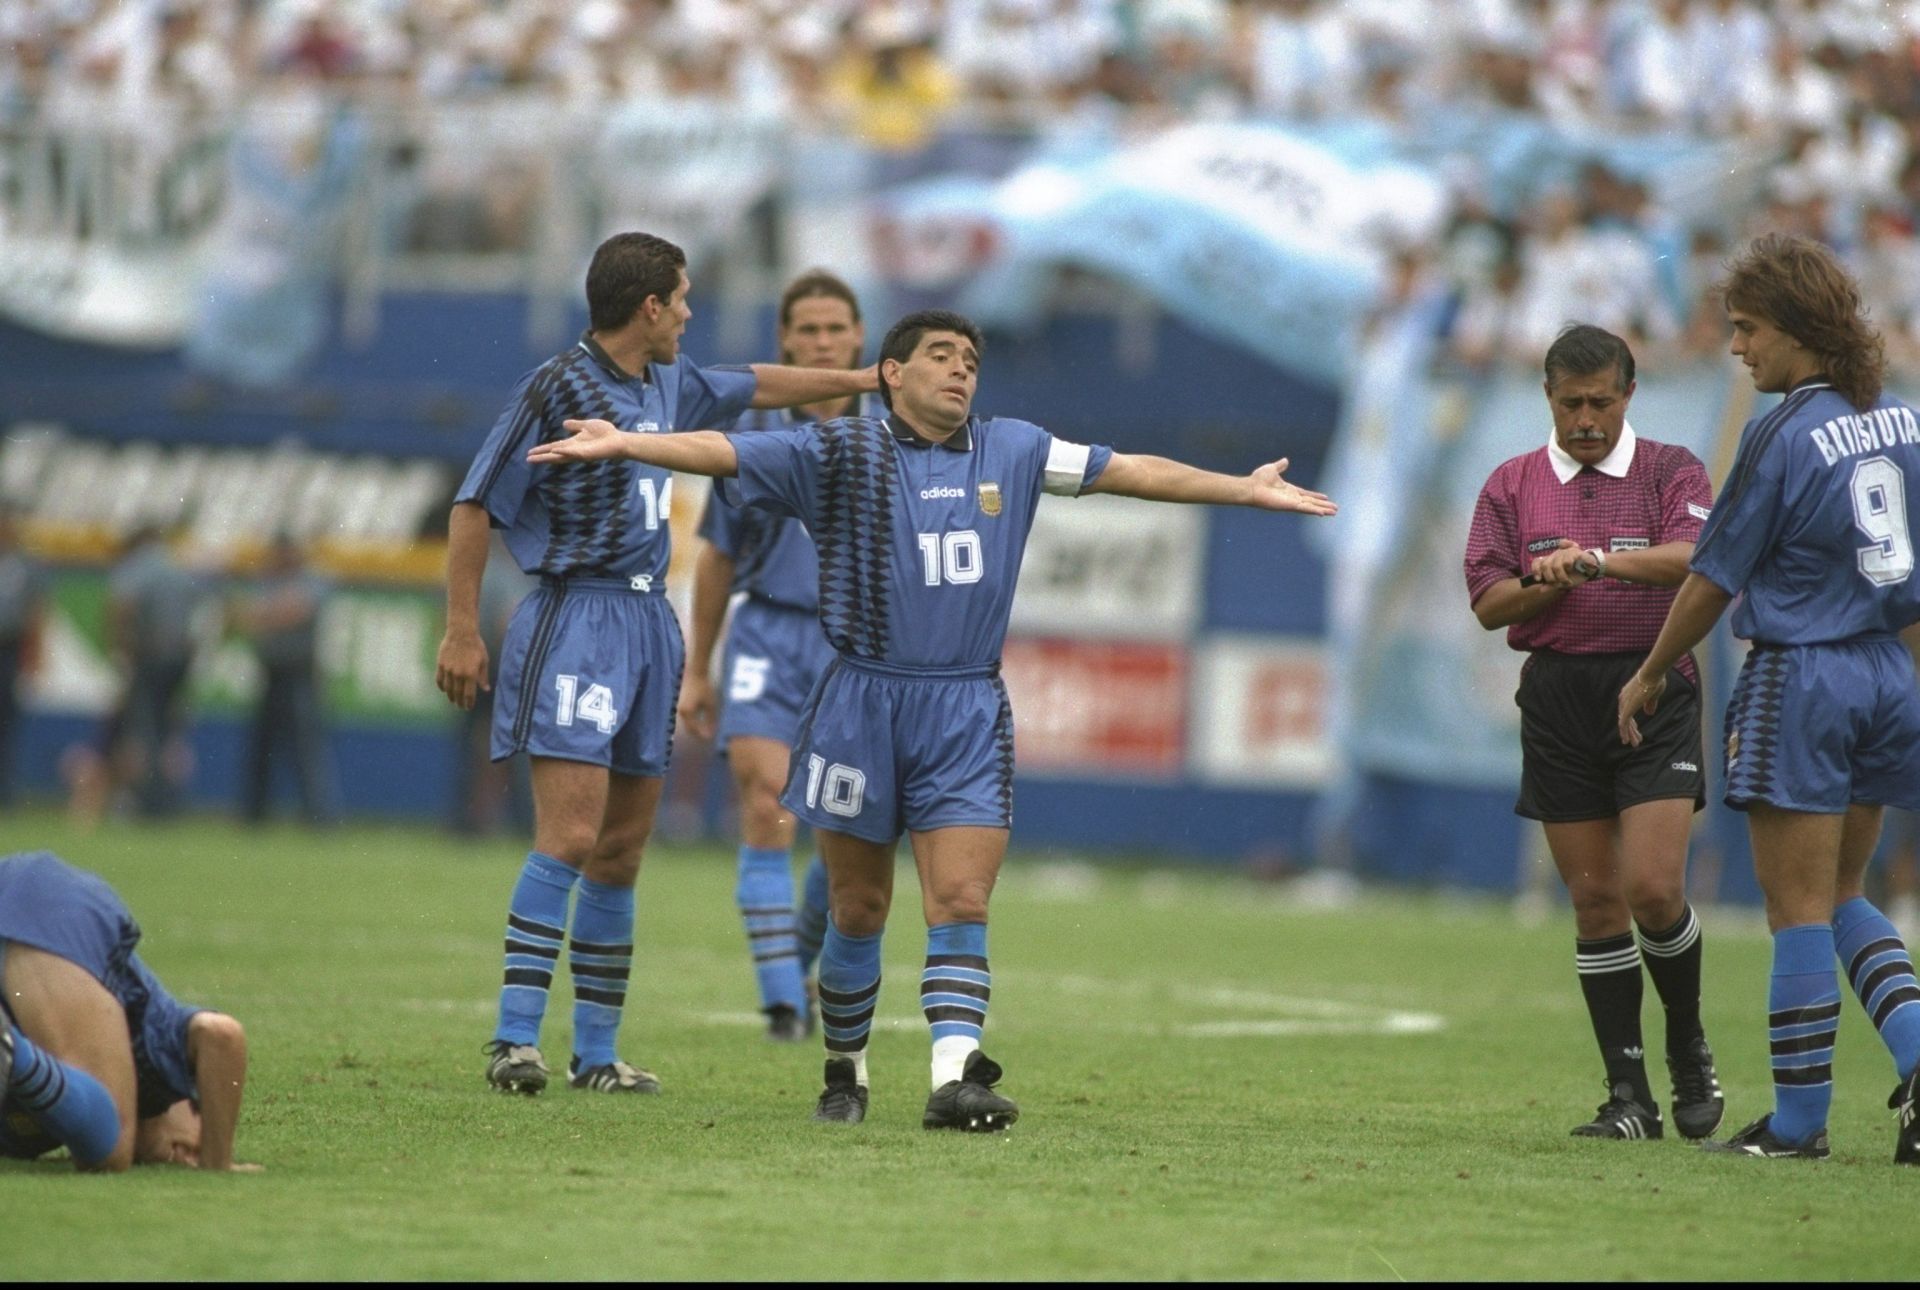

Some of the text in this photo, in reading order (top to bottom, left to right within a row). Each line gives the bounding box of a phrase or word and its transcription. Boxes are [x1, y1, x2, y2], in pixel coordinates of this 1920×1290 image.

[1810, 407, 1920, 467] BATISTUTA
[920, 486, 965, 499] adidas
[1850, 456, 1914, 587] 9
[918, 530, 984, 586] 10
[556, 674, 618, 734] 14
[731, 655, 770, 701] 5
[806, 752, 866, 818] 10
